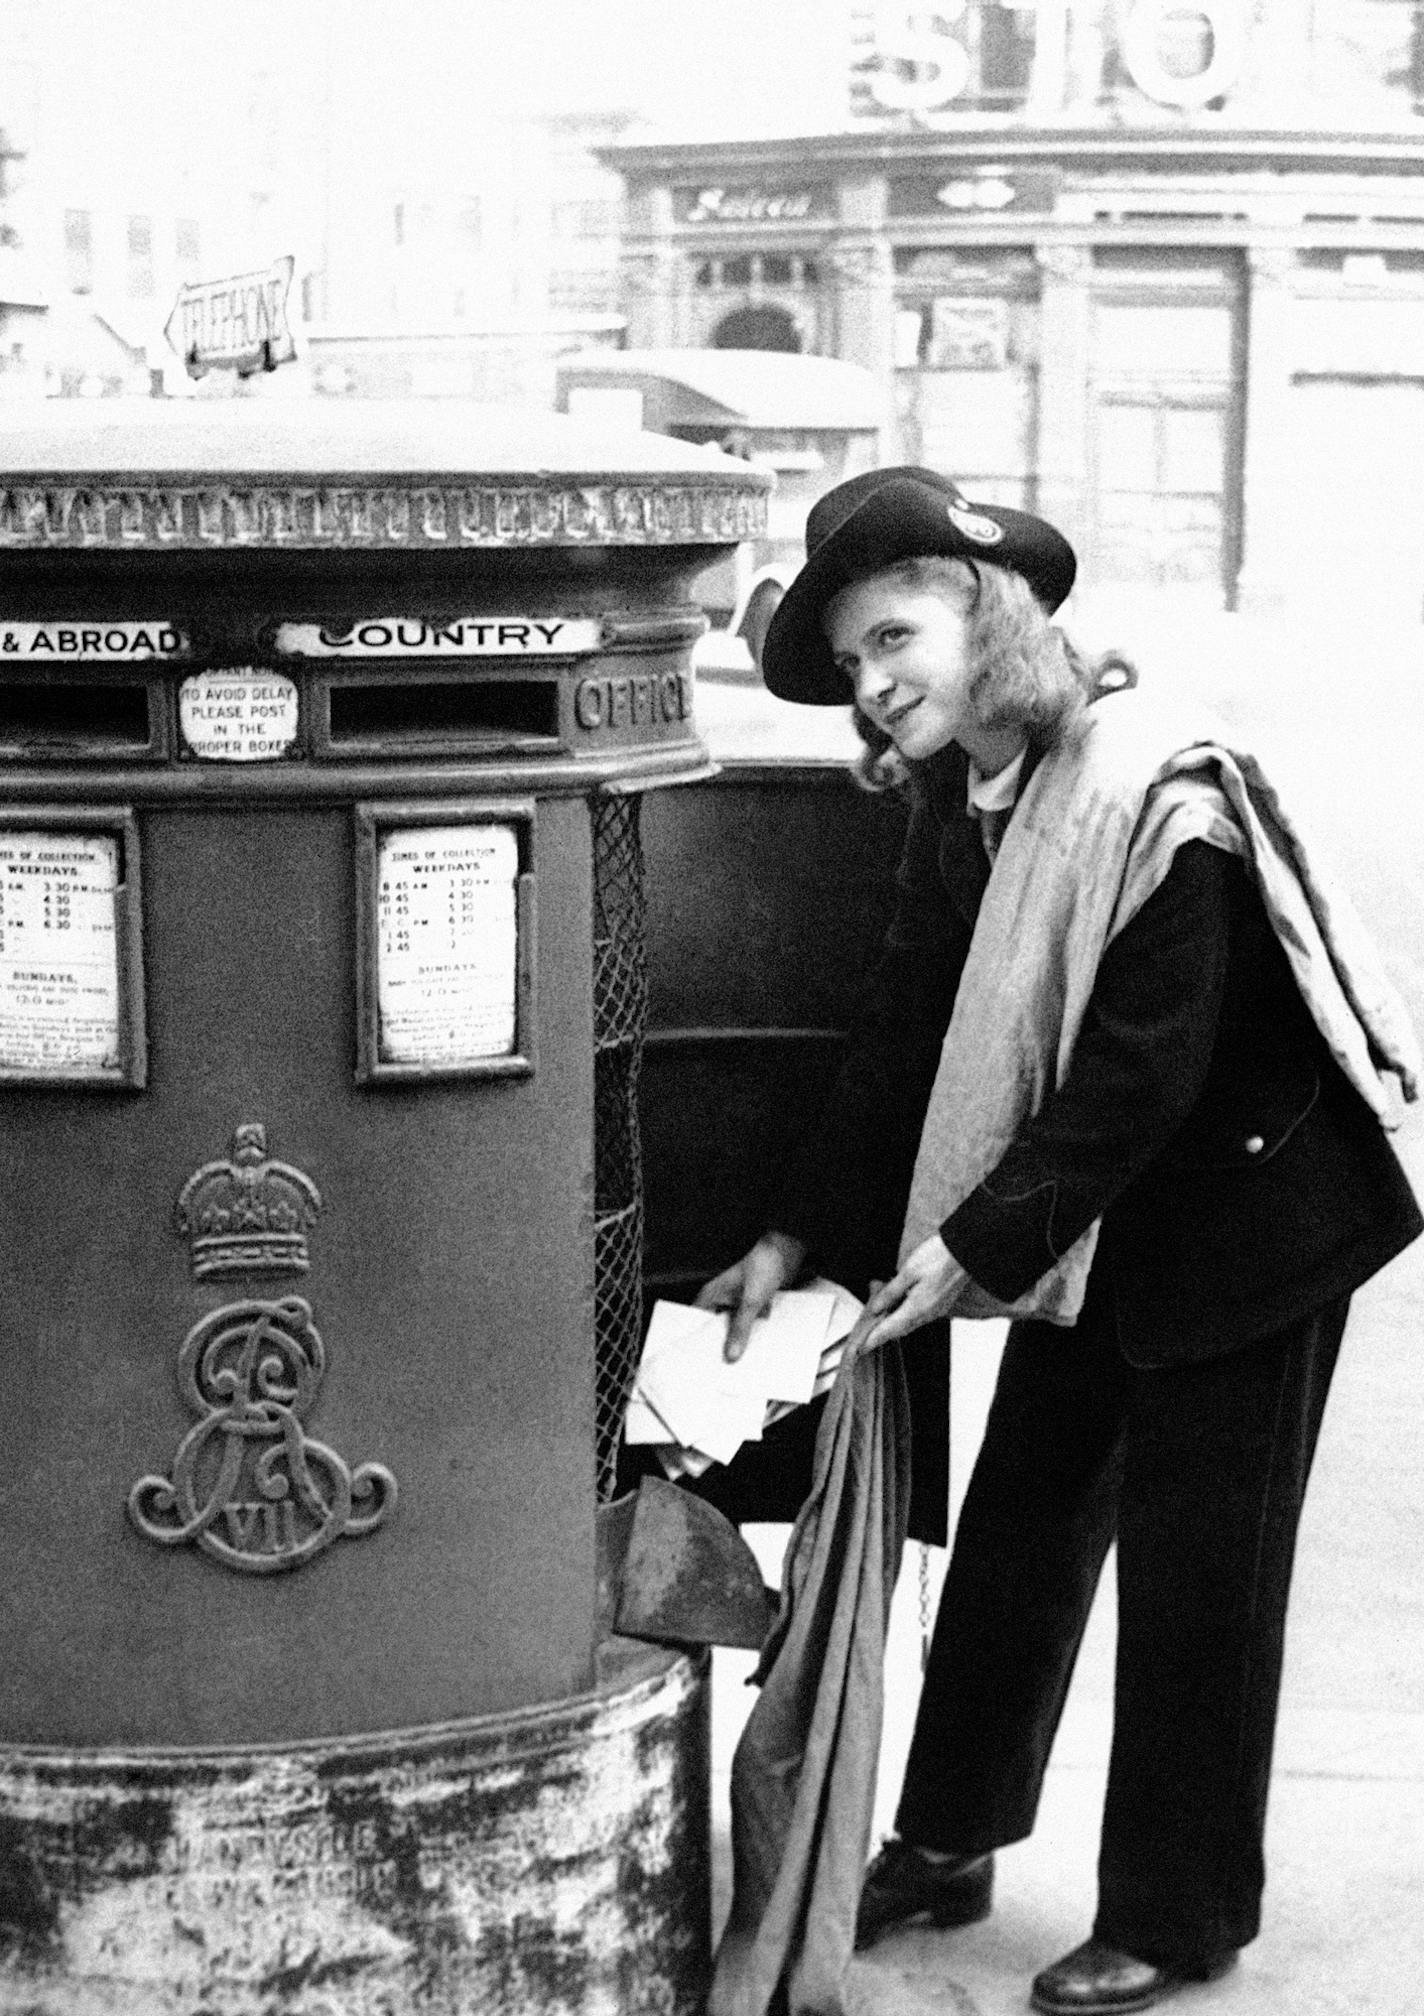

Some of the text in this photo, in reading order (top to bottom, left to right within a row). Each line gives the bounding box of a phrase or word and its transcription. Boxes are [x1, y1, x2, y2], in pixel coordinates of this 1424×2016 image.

[2, 629, 182, 653] & ABROAD
[206, 688, 246, 700] AVOID
[251, 687, 293, 701] DELAY
[191, 705, 286, 720] PLEASE POST
[213, 723, 266, 735] IN THE
[413, 862, 481, 873] WEEKDAYS
[395, 881, 409, 890] 45
[395, 893, 409, 902] 45
[396, 905, 409, 915] 45
[396, 942, 410, 952] 45
